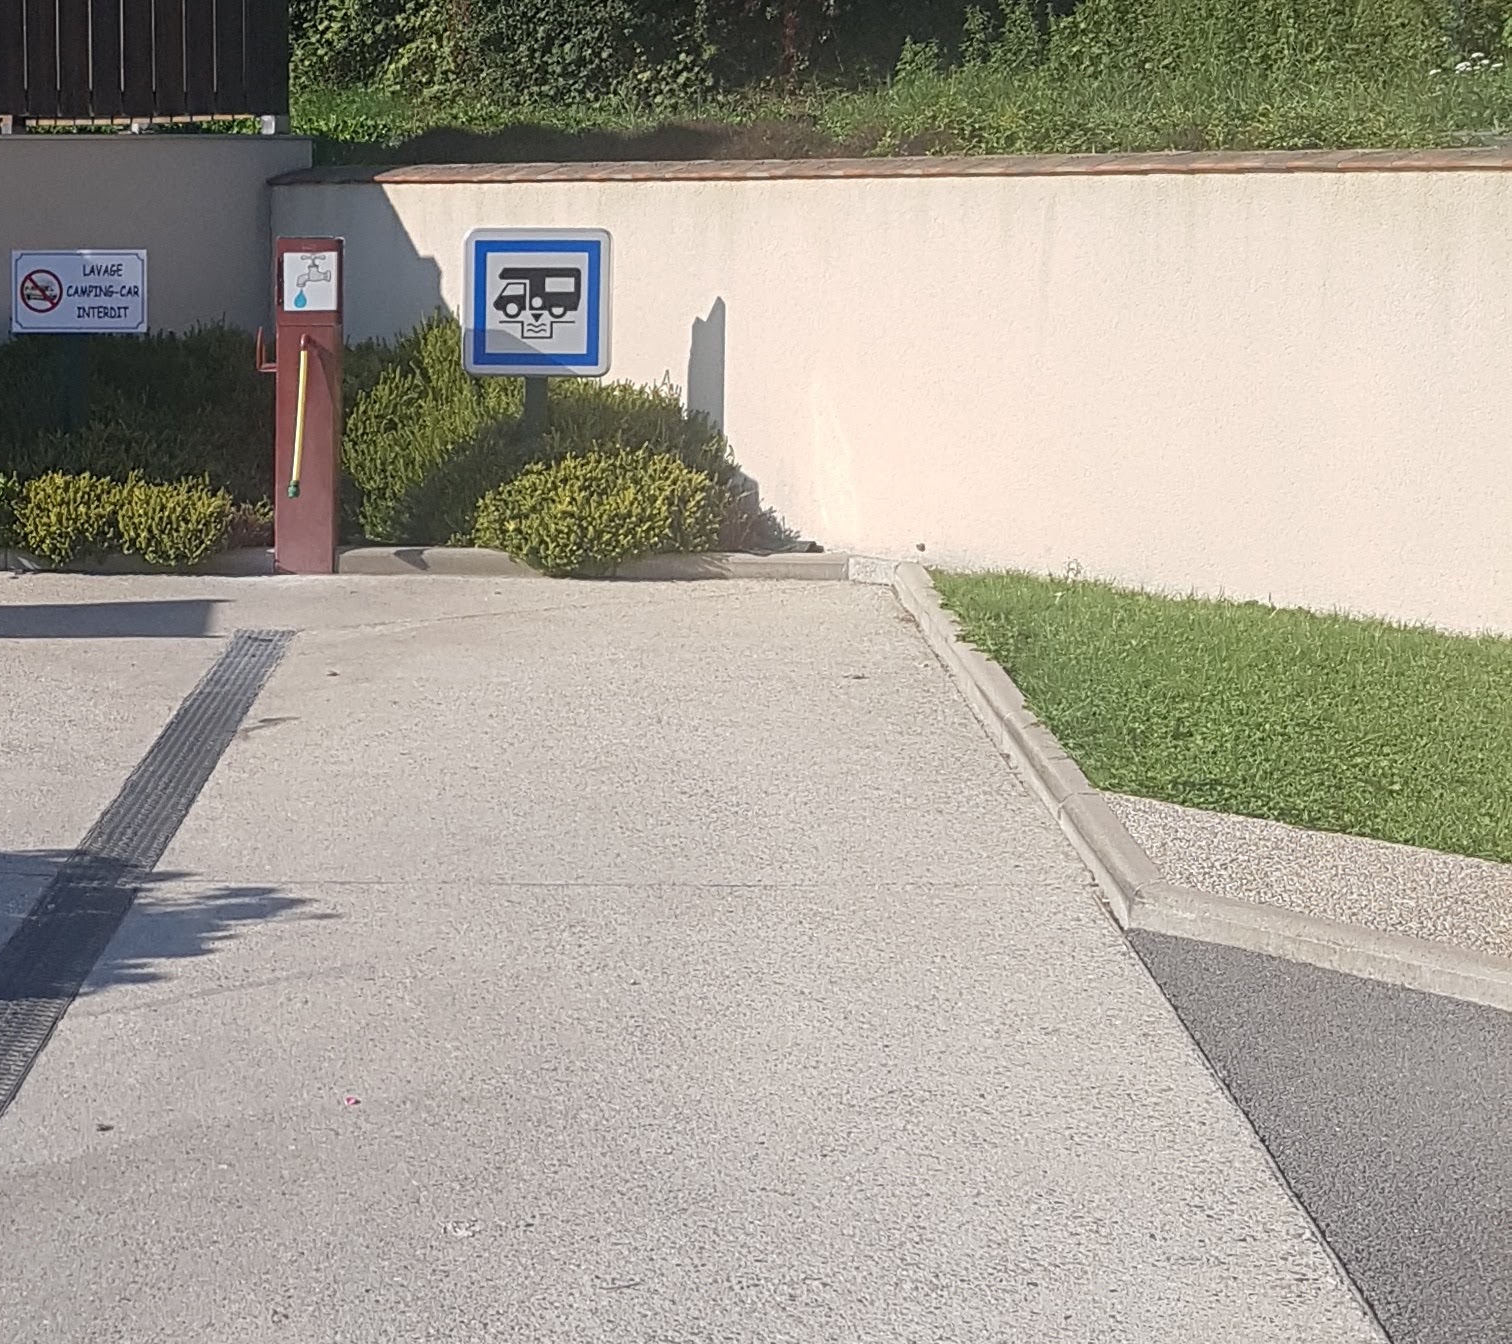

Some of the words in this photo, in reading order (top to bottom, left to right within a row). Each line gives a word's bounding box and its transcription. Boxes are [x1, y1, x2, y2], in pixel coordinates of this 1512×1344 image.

[83, 264, 123, 277] LAVAGE
[66, 284, 140, 298] CAMPING-CAR
[76, 306, 130, 319] INTERDIT
